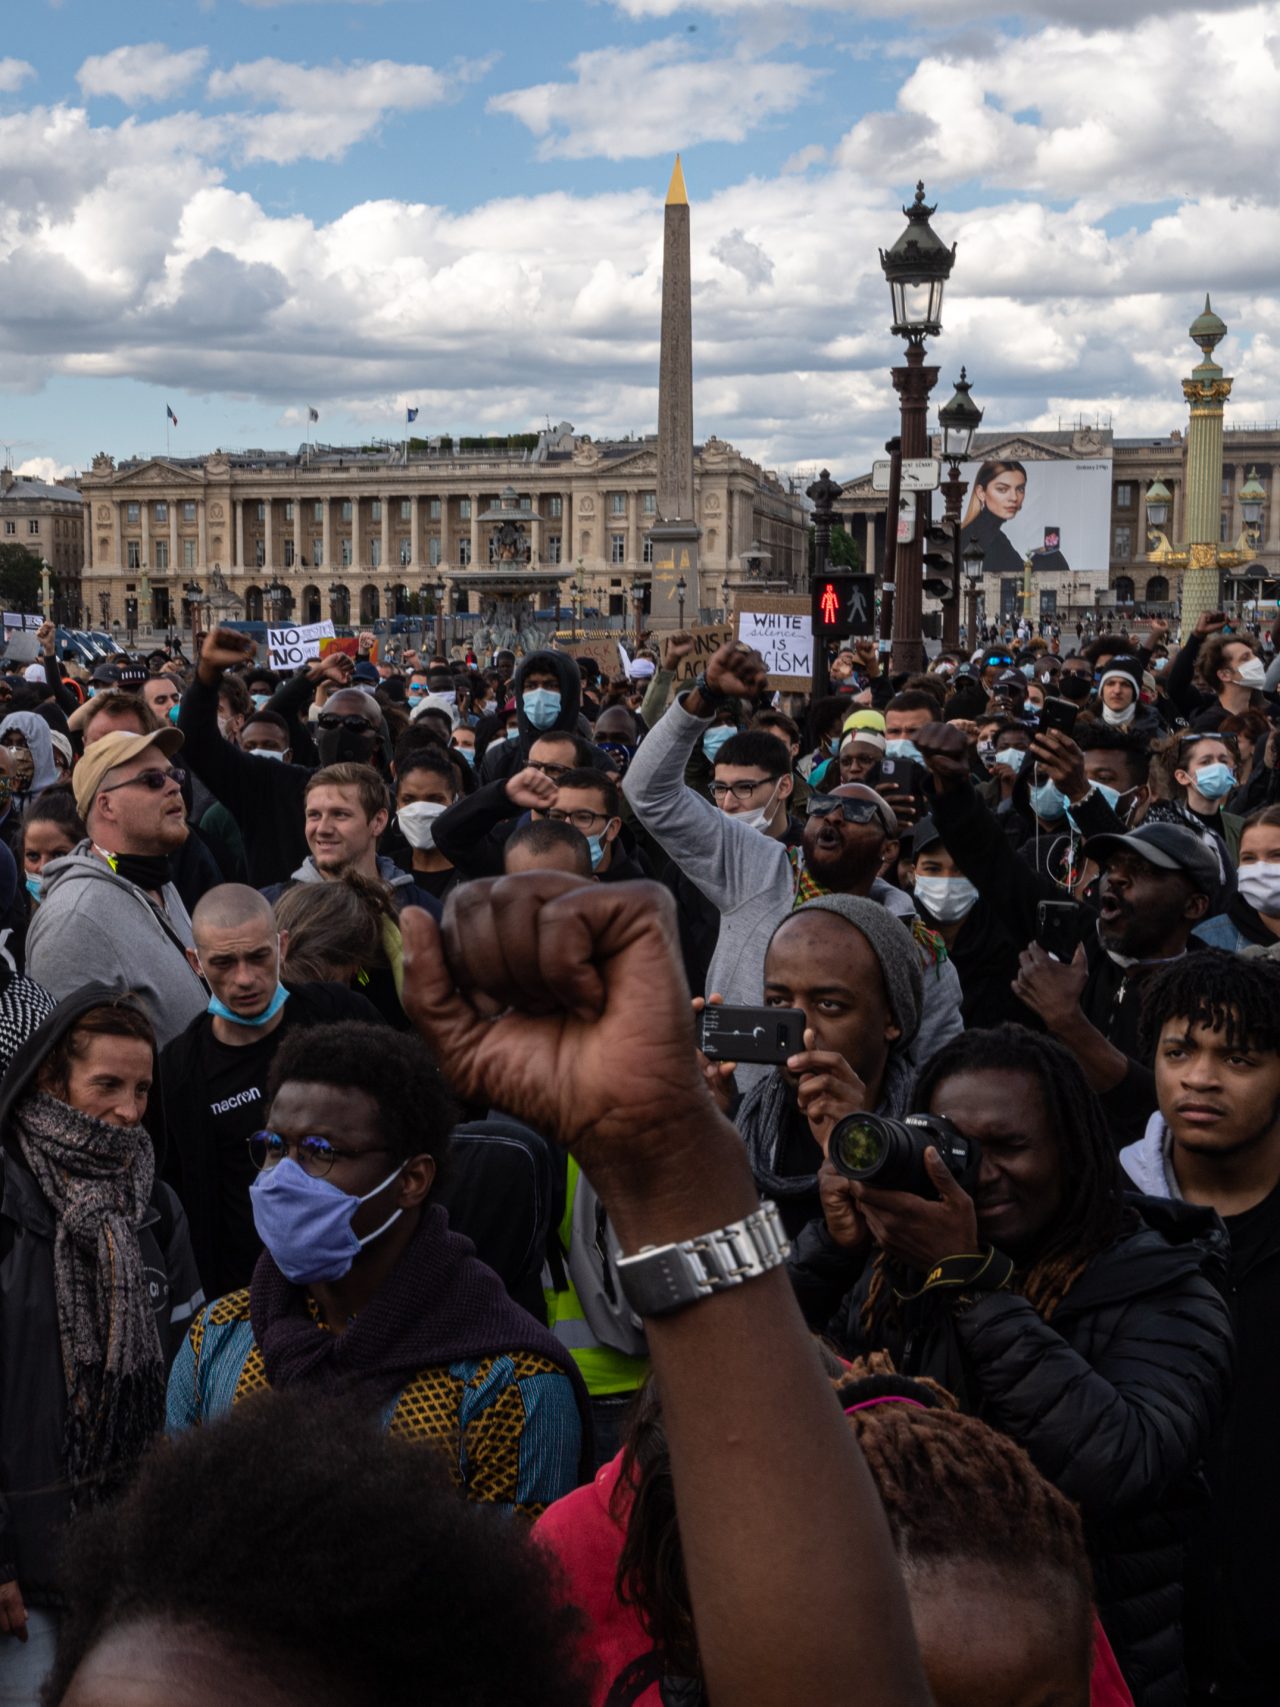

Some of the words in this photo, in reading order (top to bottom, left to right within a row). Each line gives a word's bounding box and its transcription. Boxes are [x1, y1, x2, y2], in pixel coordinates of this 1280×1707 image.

[753, 613, 802, 630] WHITE
[271, 629, 300, 646] NO
[772, 639, 787, 651] IS
[273, 647, 303, 666] NO
[763, 651, 810, 674] CISM
[905, 1117, 928, 1126] Nikon
